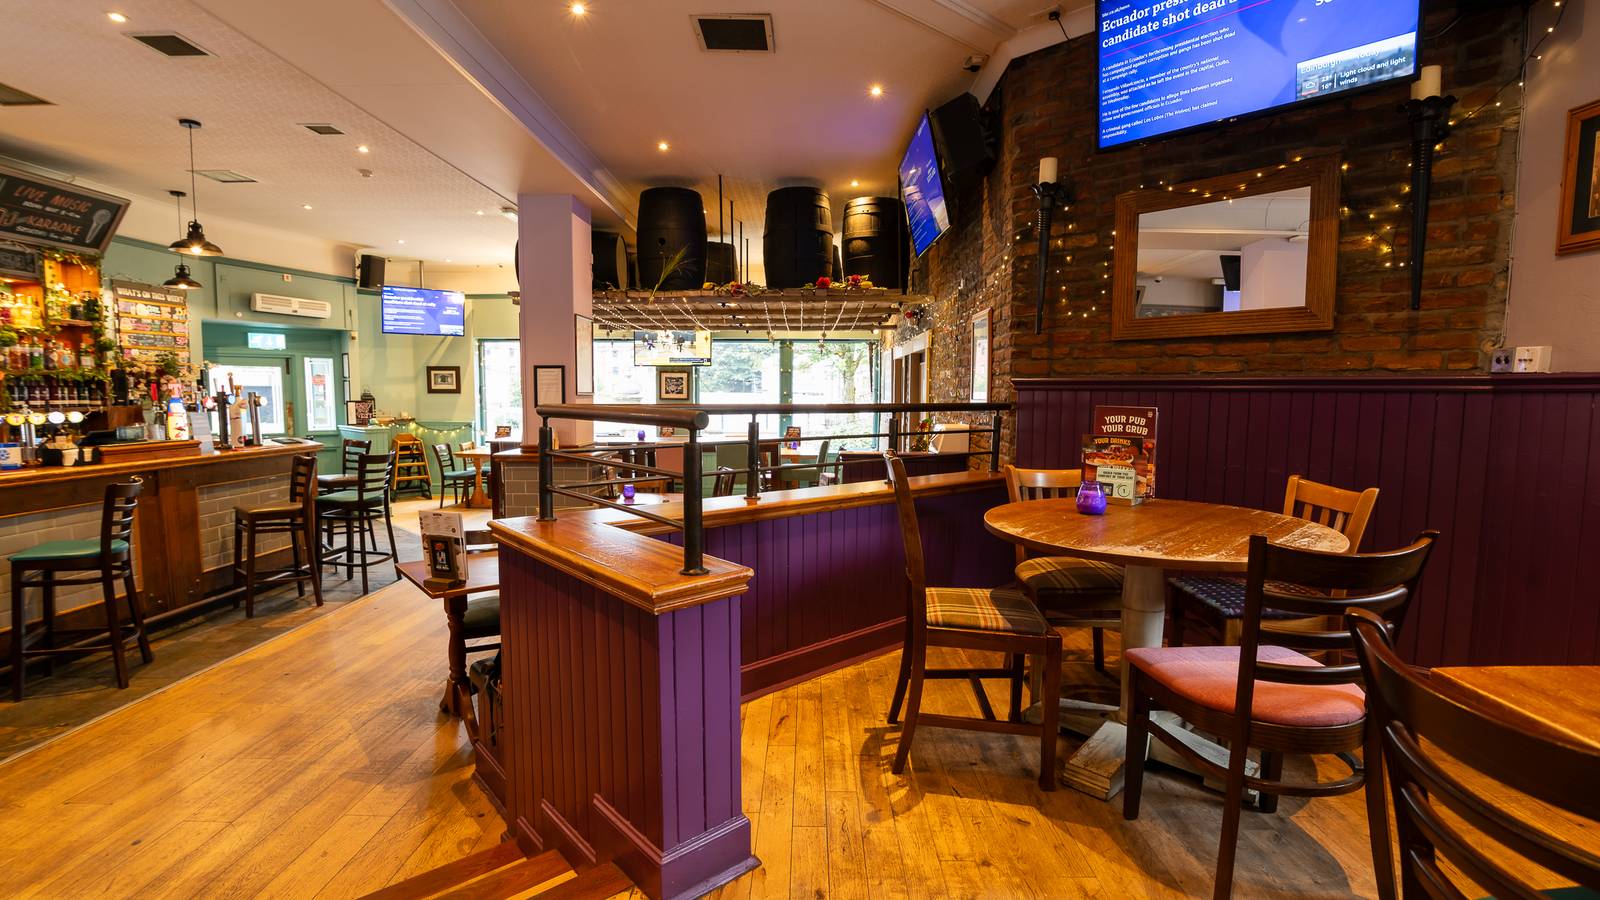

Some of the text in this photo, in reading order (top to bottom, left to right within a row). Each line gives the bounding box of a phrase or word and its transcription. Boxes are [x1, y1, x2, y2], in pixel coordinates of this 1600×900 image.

[1102, 8, 1150, 32] Ecuador
[1102, 21, 1160, 48] candidate
[1162, 8, 1190, 27] shot
[1340, 56, 1406, 78] Light cloud and light
[1340, 77, 1358, 86] winds
[14, 186, 47, 202] LIVE
[51, 195, 93, 212] MUSIC
[27, 216, 81, 235] KARAOKE
[1102, 425, 1148, 435] YOUR GRUB
[1104, 416, 1146, 426] YOUR PUB
[1110, 438, 1131, 446] DRINKS
